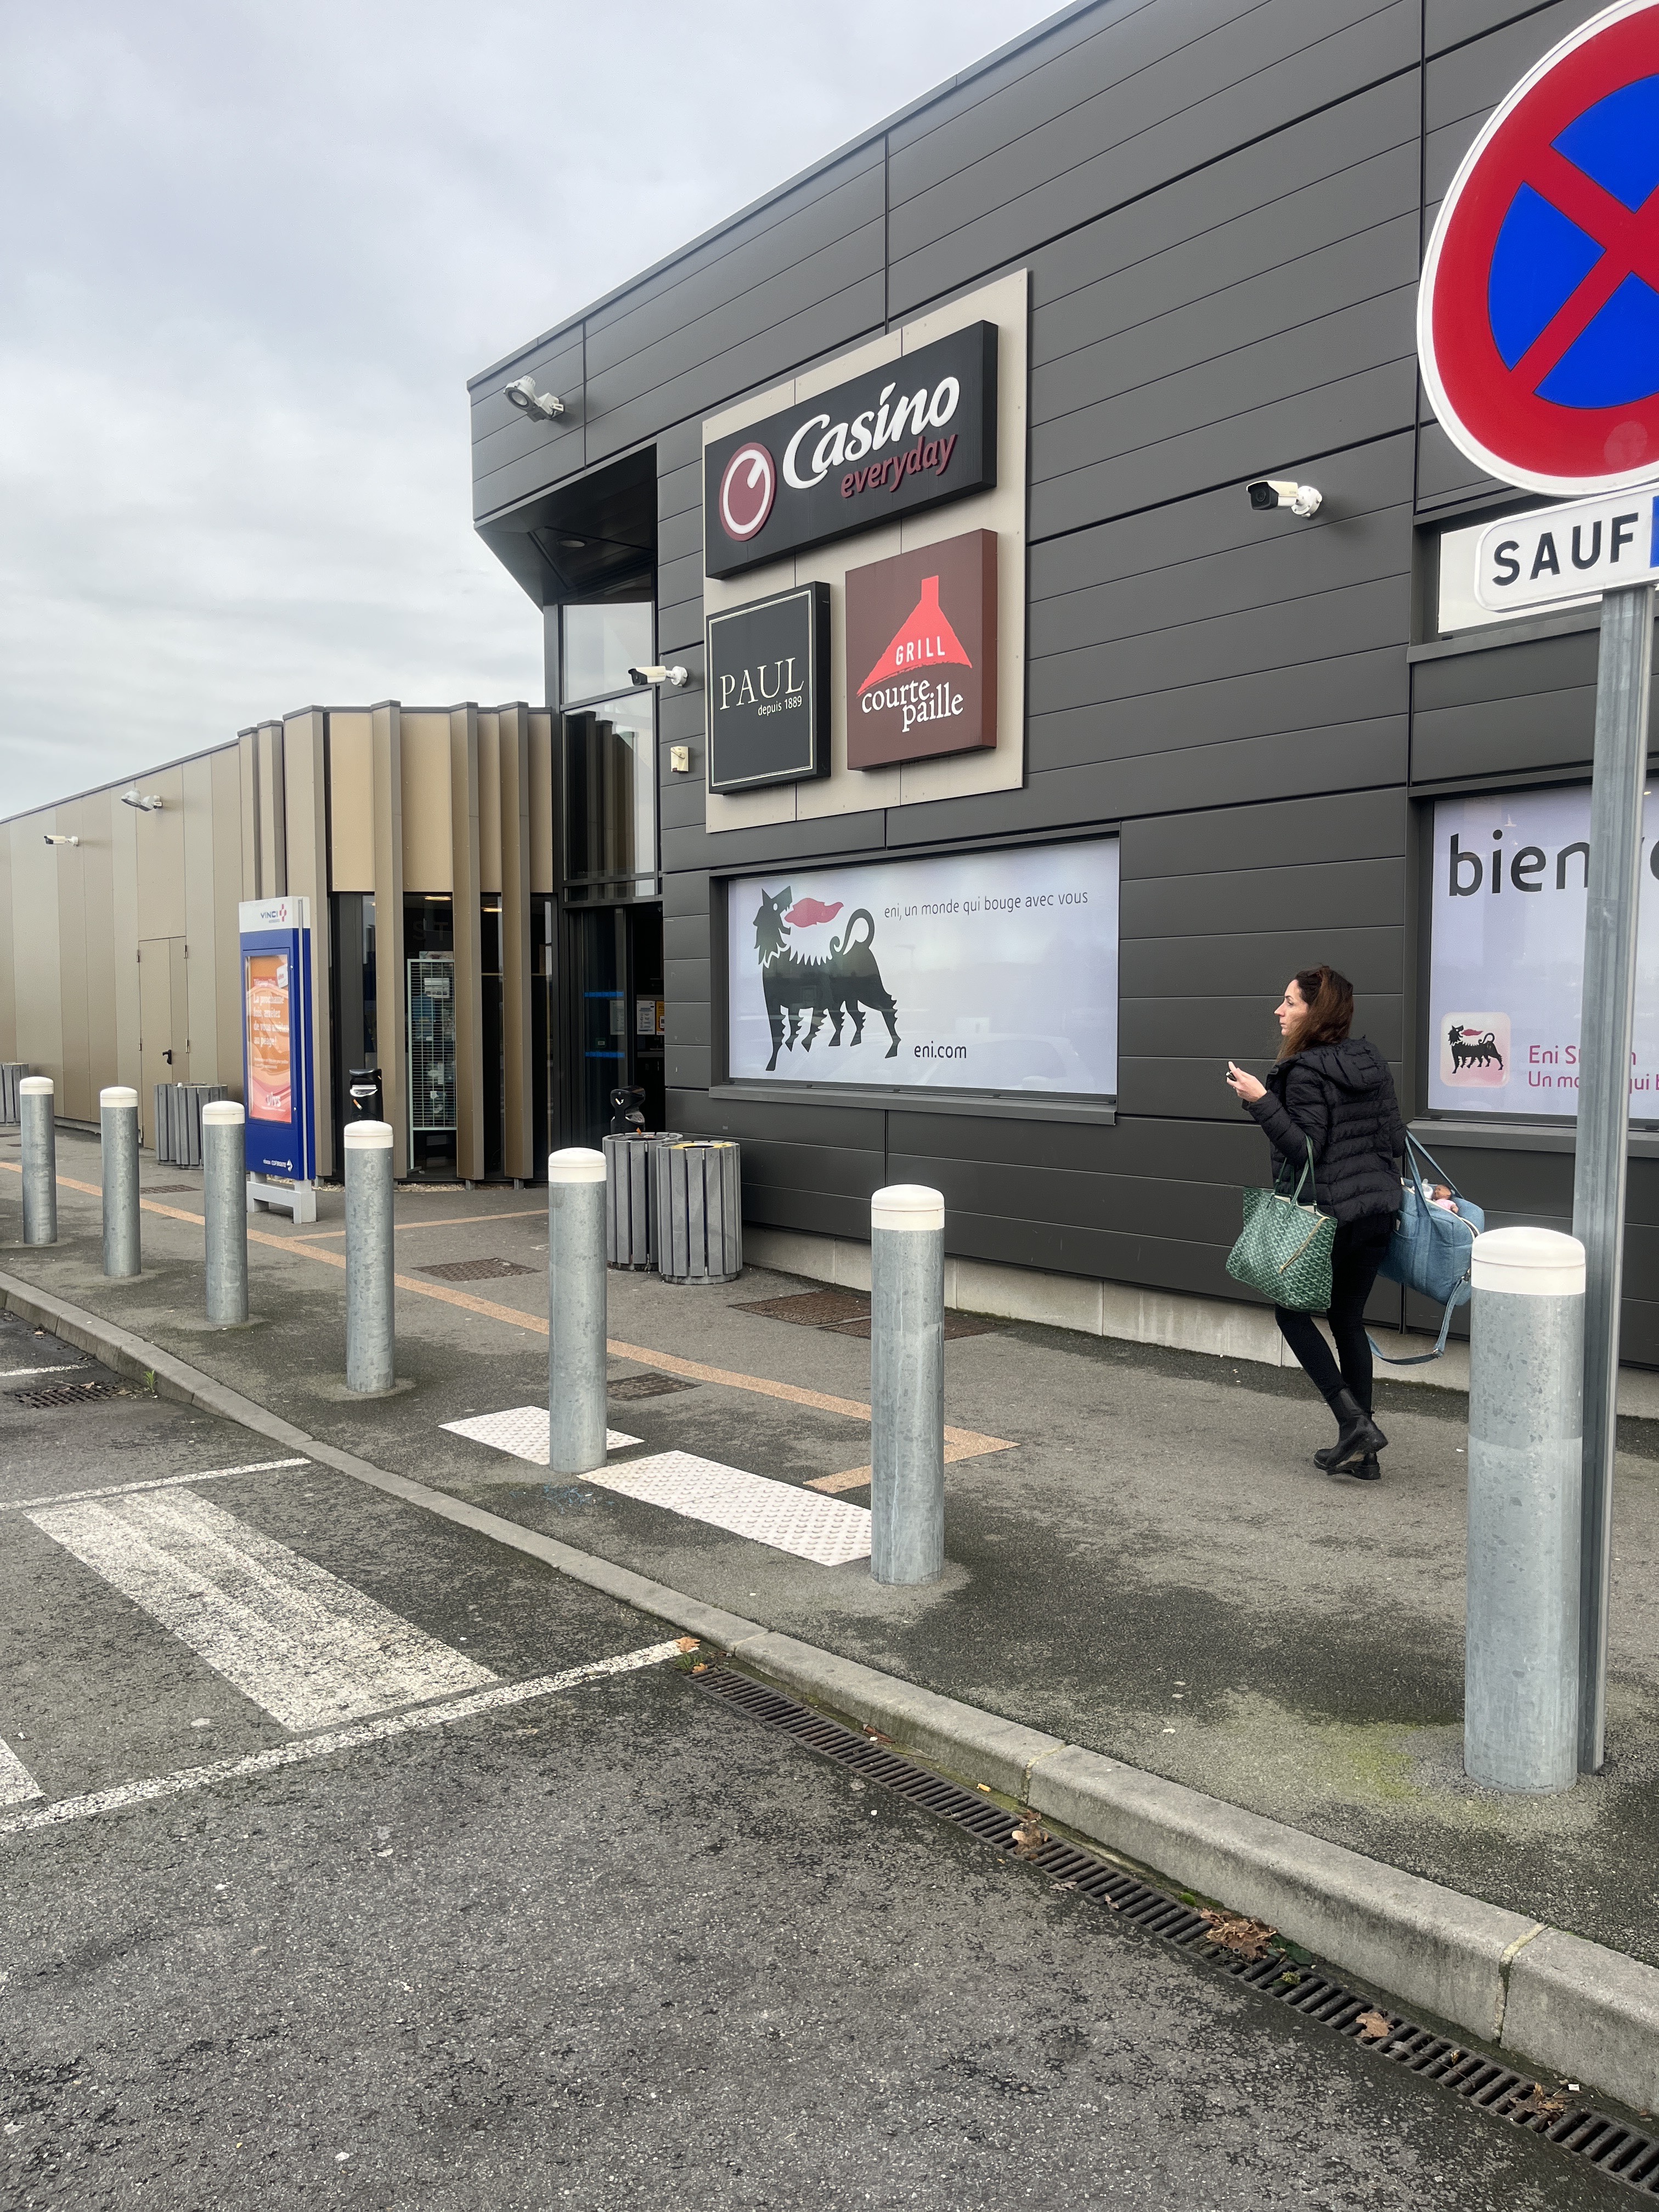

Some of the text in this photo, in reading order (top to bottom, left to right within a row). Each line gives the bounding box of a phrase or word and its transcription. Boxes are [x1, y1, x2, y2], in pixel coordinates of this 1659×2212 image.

[782, 376, 960, 489] Casino
[840, 433, 958, 499] everyday
[1492, 512, 1639, 586] SAUF
[895, 635, 946, 666] GRILL
[719, 657, 805, 711] PAUL
[861, 679, 930, 714] courte
[758, 695, 803, 716] depuis 1889
[901, 681, 964, 733] paille
[260, 910, 279, 919] VINCI
[884, 891, 1088, 921] eni, un monde qui bouge avec vous
[913, 1040, 967, 1059] eni.com
[1528, 1045, 1559, 1064] Eni
[1528, 1070, 1552, 1087] Un
